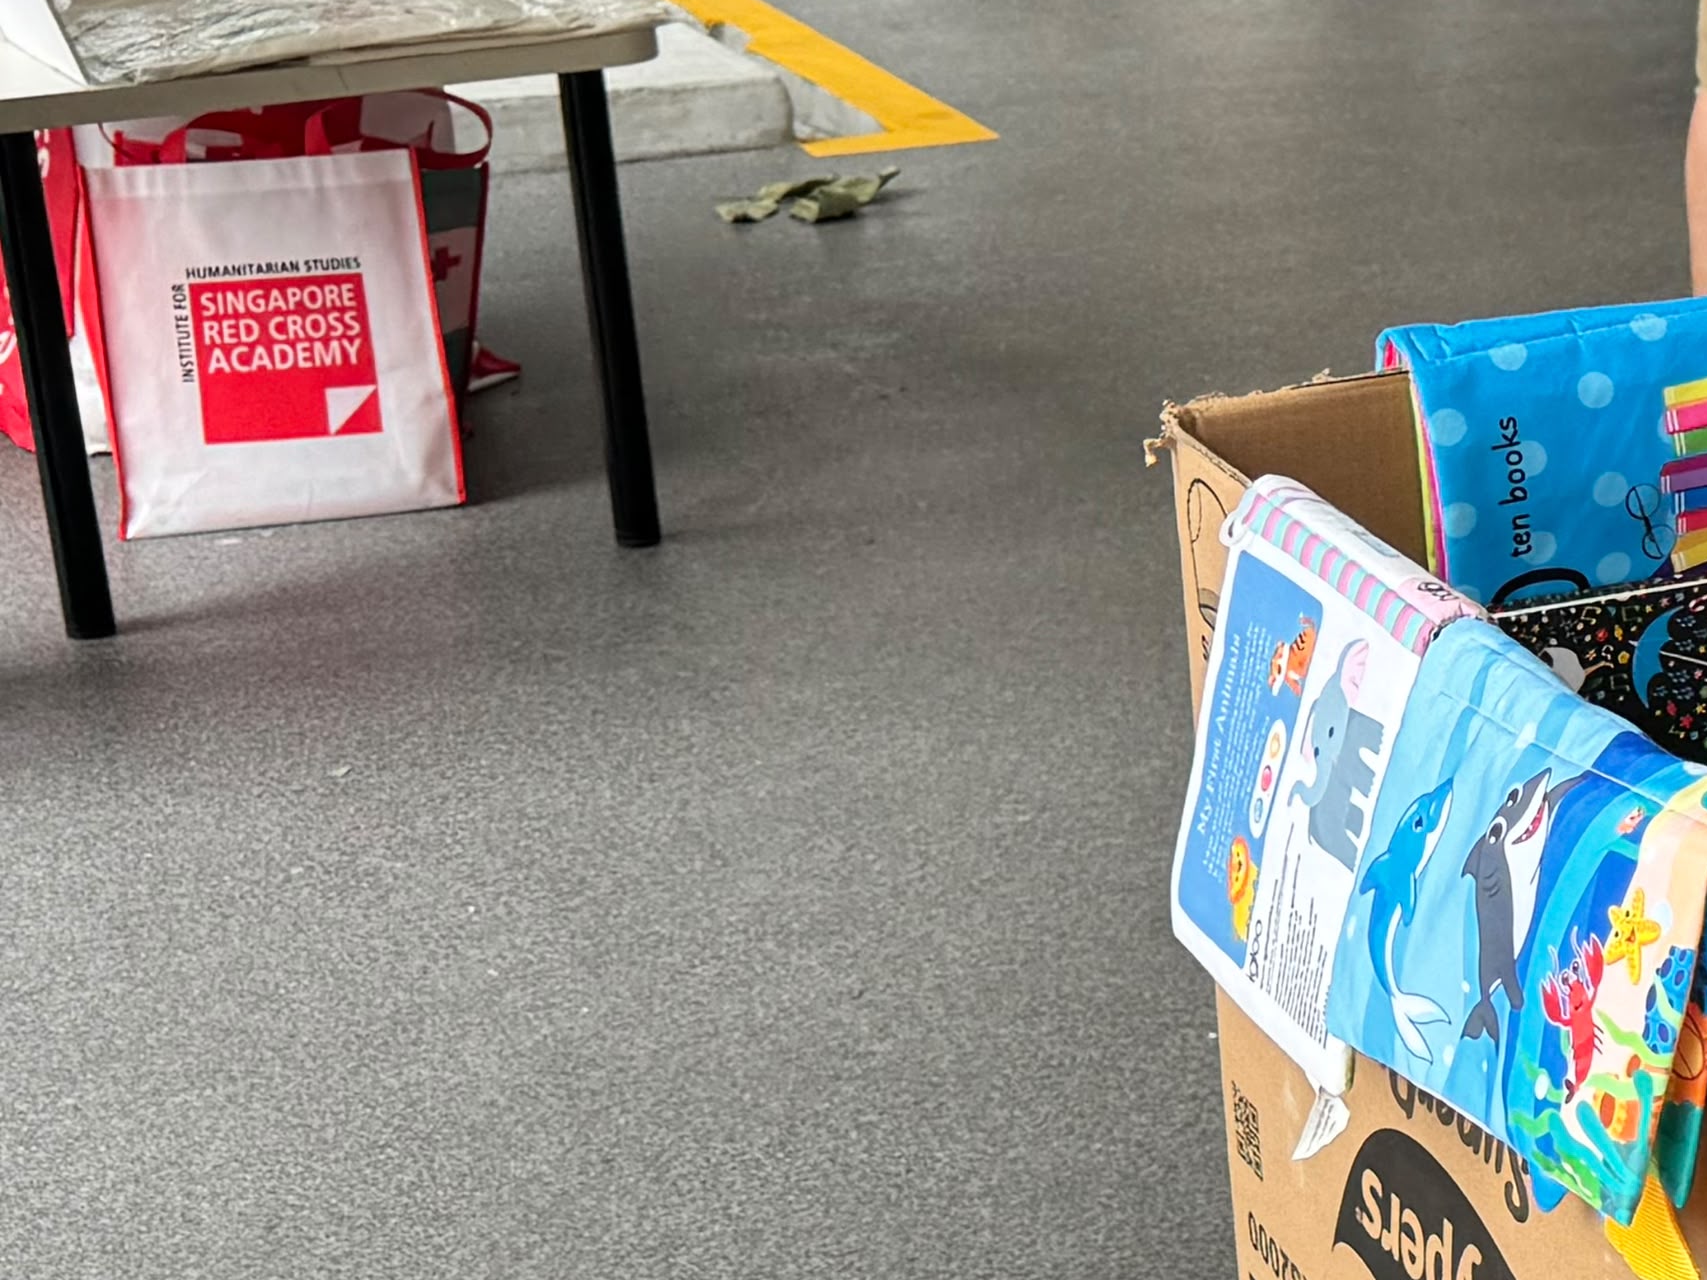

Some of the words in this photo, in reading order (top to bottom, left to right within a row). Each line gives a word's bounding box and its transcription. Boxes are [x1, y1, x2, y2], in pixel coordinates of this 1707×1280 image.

[185, 260, 300, 279] HUMANITARIAN
[304, 257, 361, 274] STUDIES
[171, 284, 189, 313] FOR
[200, 283, 356, 317] SINGAPORE
[204, 318, 260, 346] RED
[269, 311, 361, 341] CROSS
[177, 316, 195, 383] INSTITUTE
[208, 338, 362, 374] ACADEMY
[1490, 415, 1529, 506] books
[1511, 513, 1533, 557] ten
[1196, 798, 1216, 836] My
[1214, 633, 1241, 729] Animals
